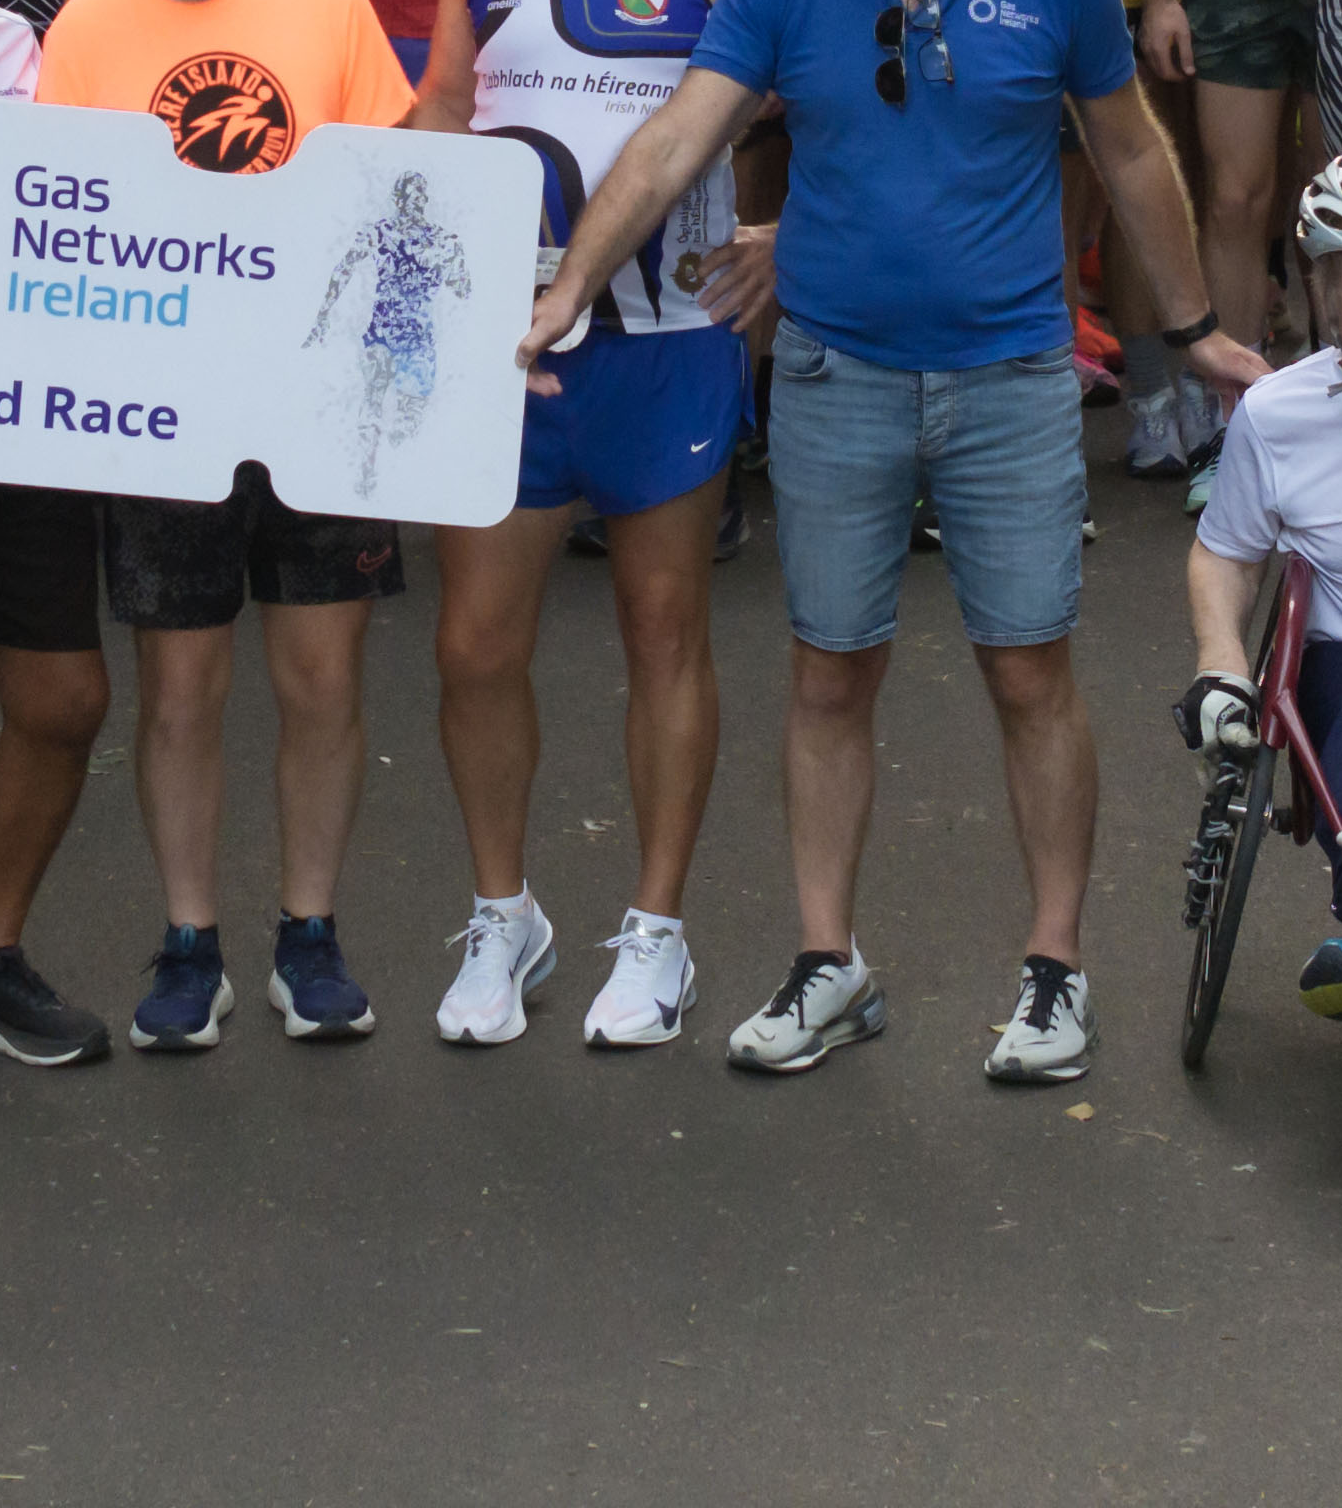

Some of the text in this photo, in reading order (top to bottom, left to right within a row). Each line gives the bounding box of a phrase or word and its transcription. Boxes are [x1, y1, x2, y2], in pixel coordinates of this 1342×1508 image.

[178, 60, 263, 96] ISLAND
[550, 75, 578, 91] na
[583, 71, 674, 99] hÉireann
[605, 100, 636, 115] Irish
[259, 126, 287, 164] RUN
[15, 165, 111, 212] Gas
[11, 217, 277, 280] Networks
[7, 272, 190, 328] Ireland
[44, 385, 180, 440] Race
